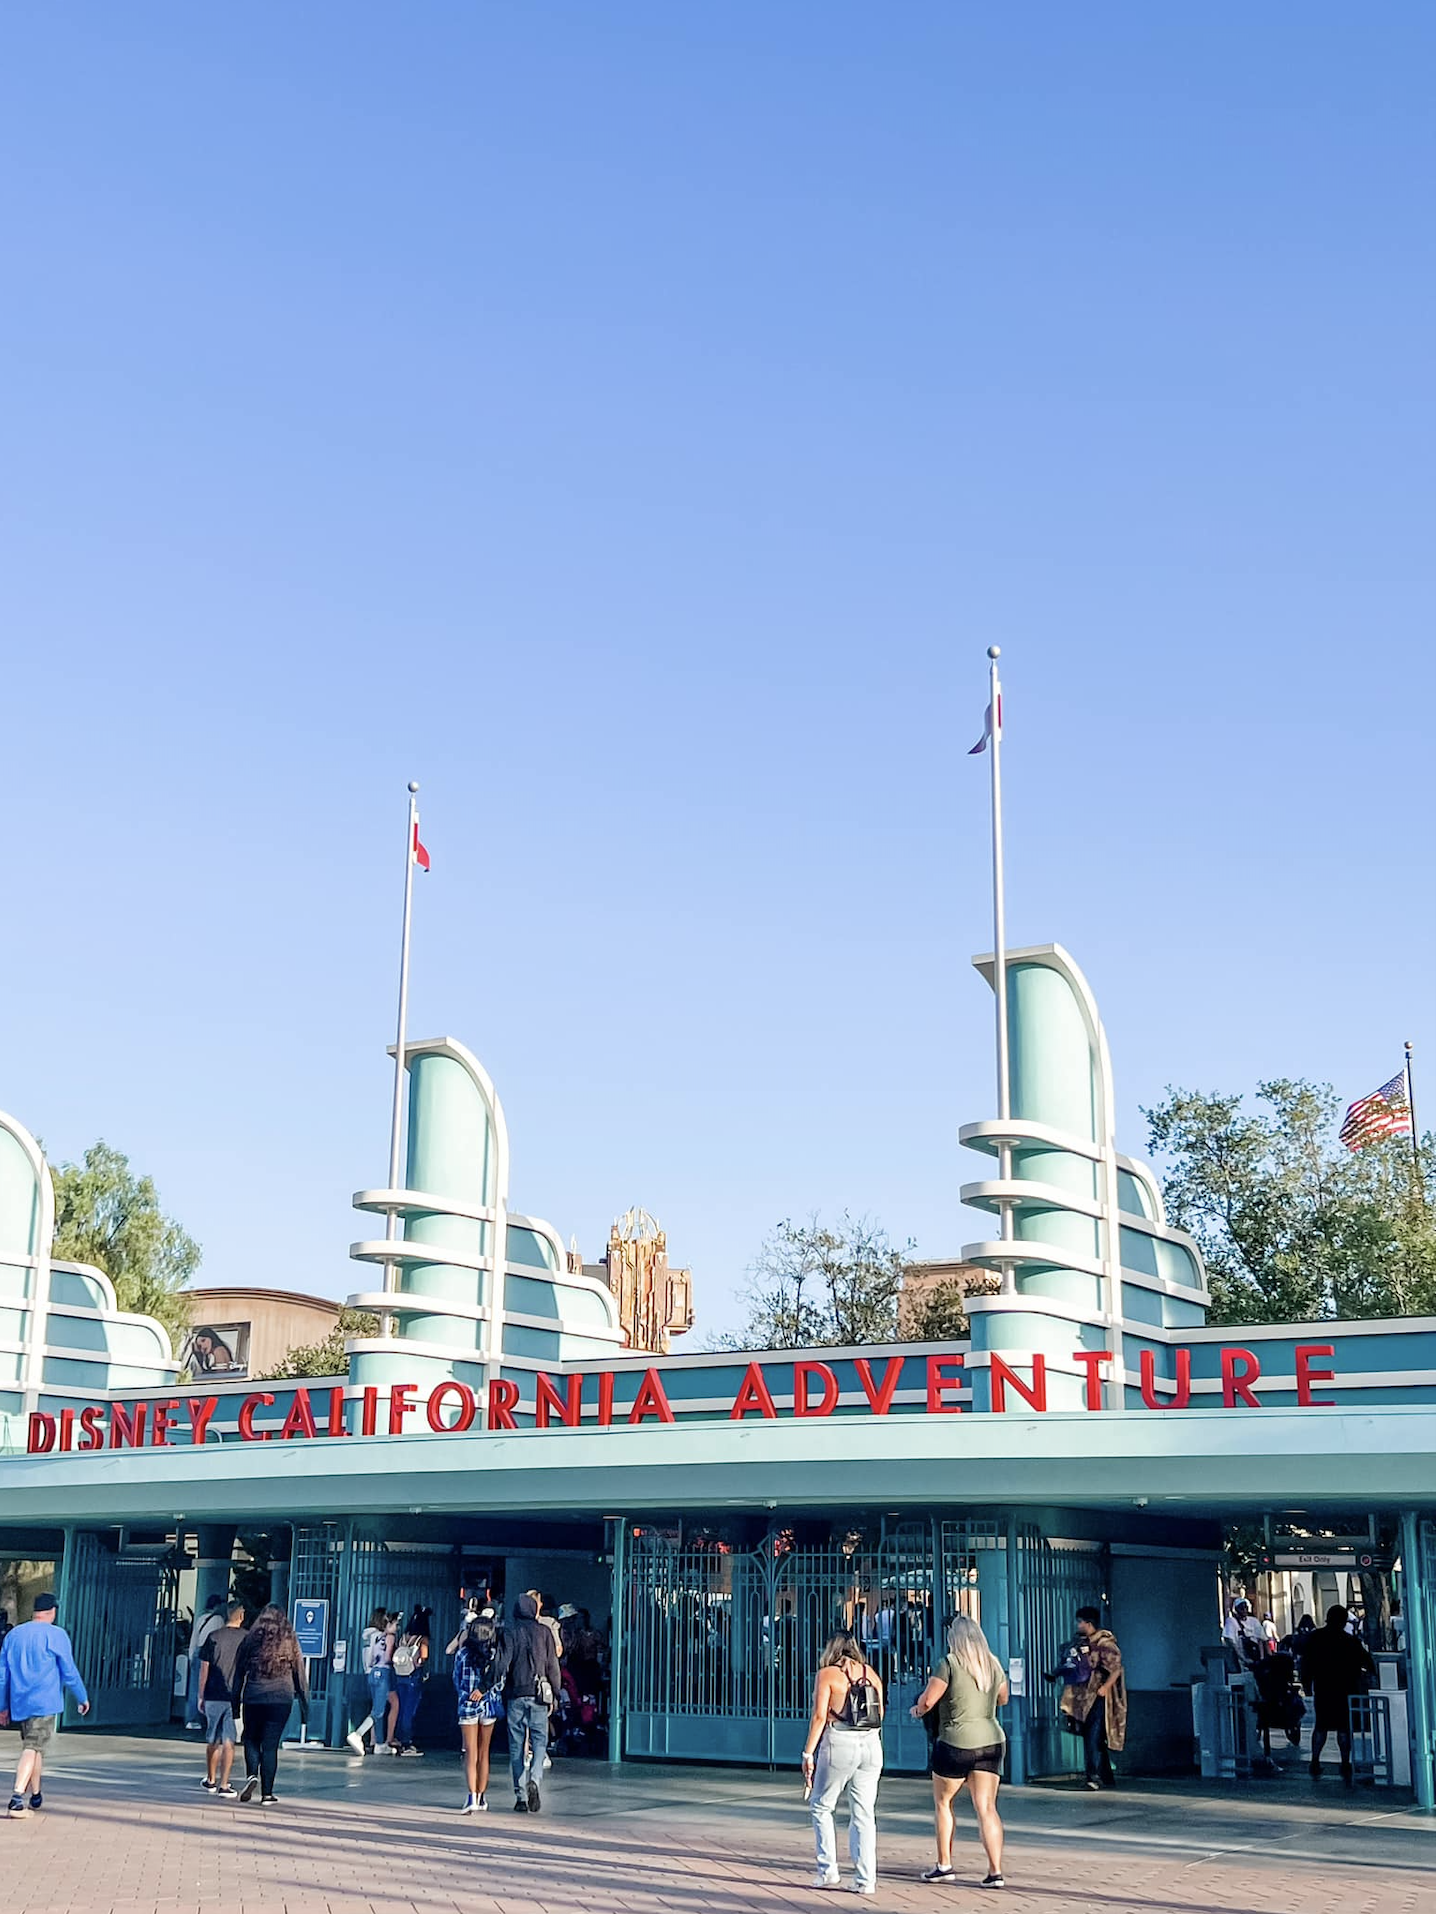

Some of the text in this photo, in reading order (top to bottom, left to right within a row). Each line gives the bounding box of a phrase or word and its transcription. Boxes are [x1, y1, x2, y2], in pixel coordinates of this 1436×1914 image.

[28, 1345, 1336, 1454] DISNEY CALIFORNIA ADVENTURE
[1299, 1555, 1331, 1564] Exit Only
